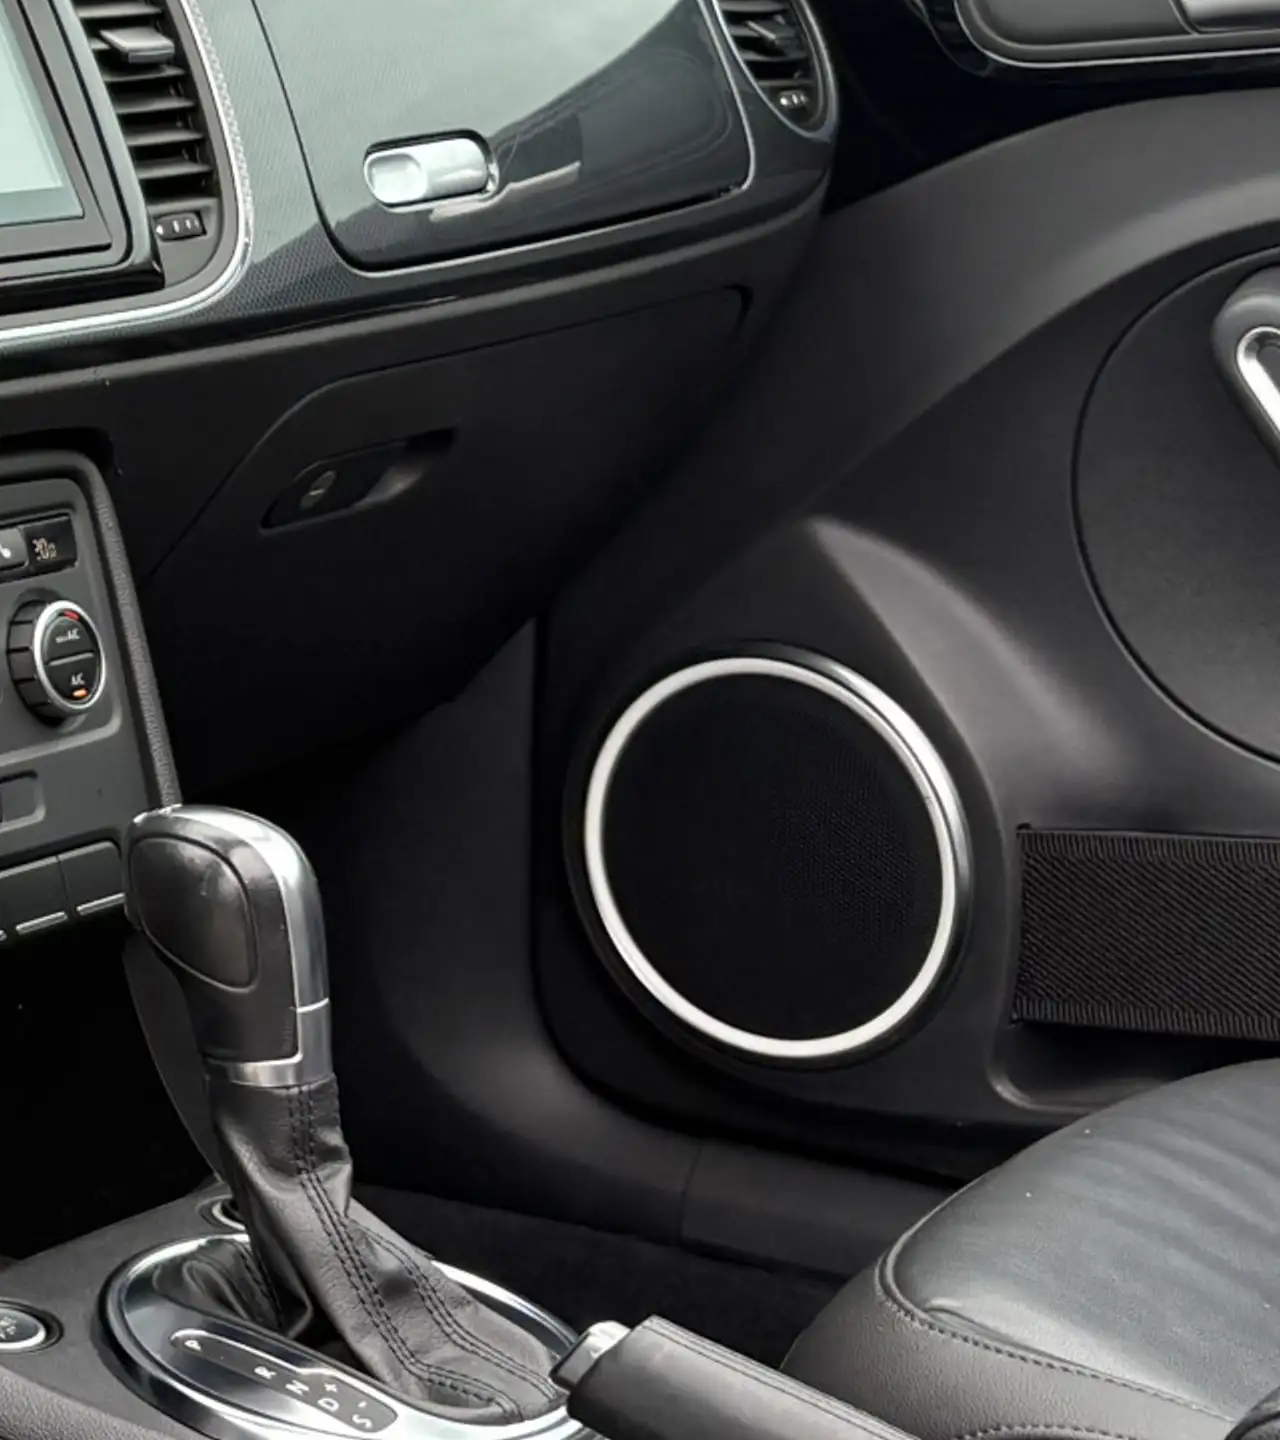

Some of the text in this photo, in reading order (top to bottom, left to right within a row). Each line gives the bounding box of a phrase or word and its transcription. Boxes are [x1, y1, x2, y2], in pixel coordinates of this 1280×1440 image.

[184, 1339, 201, 1351] P
[254, 1366, 277, 1379] R
[285, 1380, 310, 1395] N
[317, 1397, 339, 1411] D
[352, 1413, 372, 1428] S
